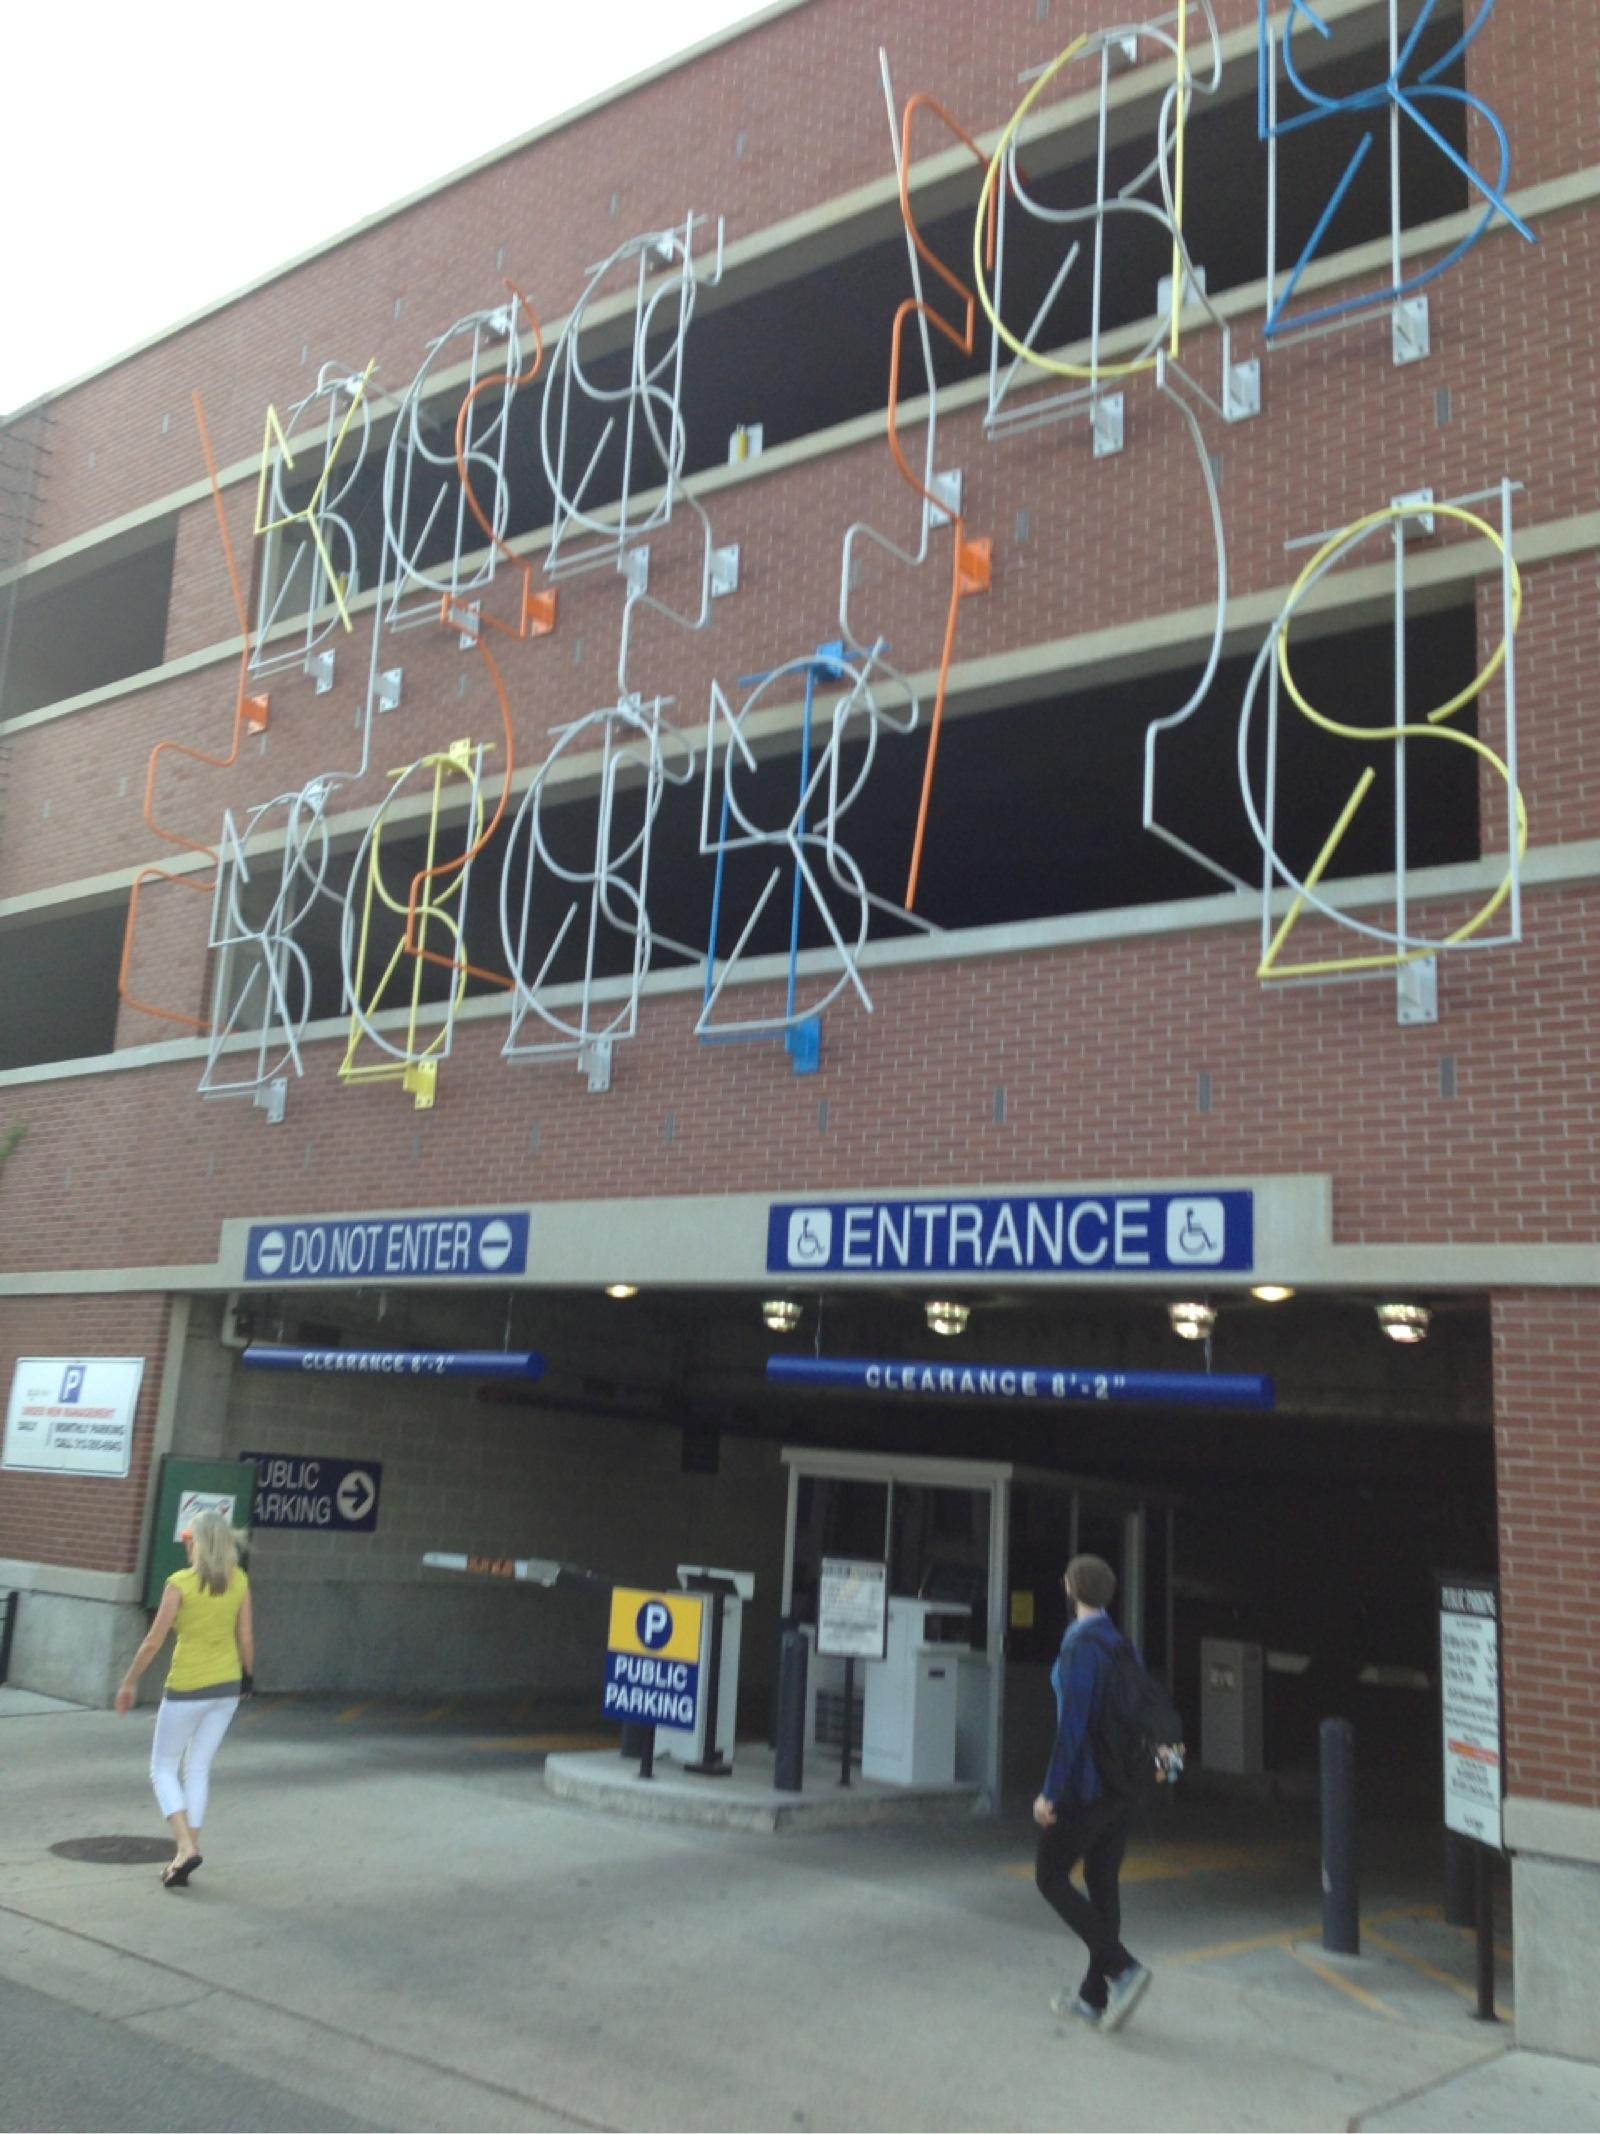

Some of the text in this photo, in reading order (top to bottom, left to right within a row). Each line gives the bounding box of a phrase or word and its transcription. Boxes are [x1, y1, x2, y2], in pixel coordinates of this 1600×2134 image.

[290, 1221, 471, 1273] DO NOT ENTER
[843, 1200, 1151, 1267] ENTRANCE
[302, 1352, 404, 1373] CLEARANCE
[62, 1369, 81, 1400] P
[866, 1365, 1037, 1396] CLEARANCE
[246, 1458, 320, 1490] UBLIC
[253, 1493, 331, 1524] ARKING
[645, 1604, 668, 1643] P
[614, 1656, 688, 1691] PUBLIC
[604, 1683, 694, 1723] PARKING
